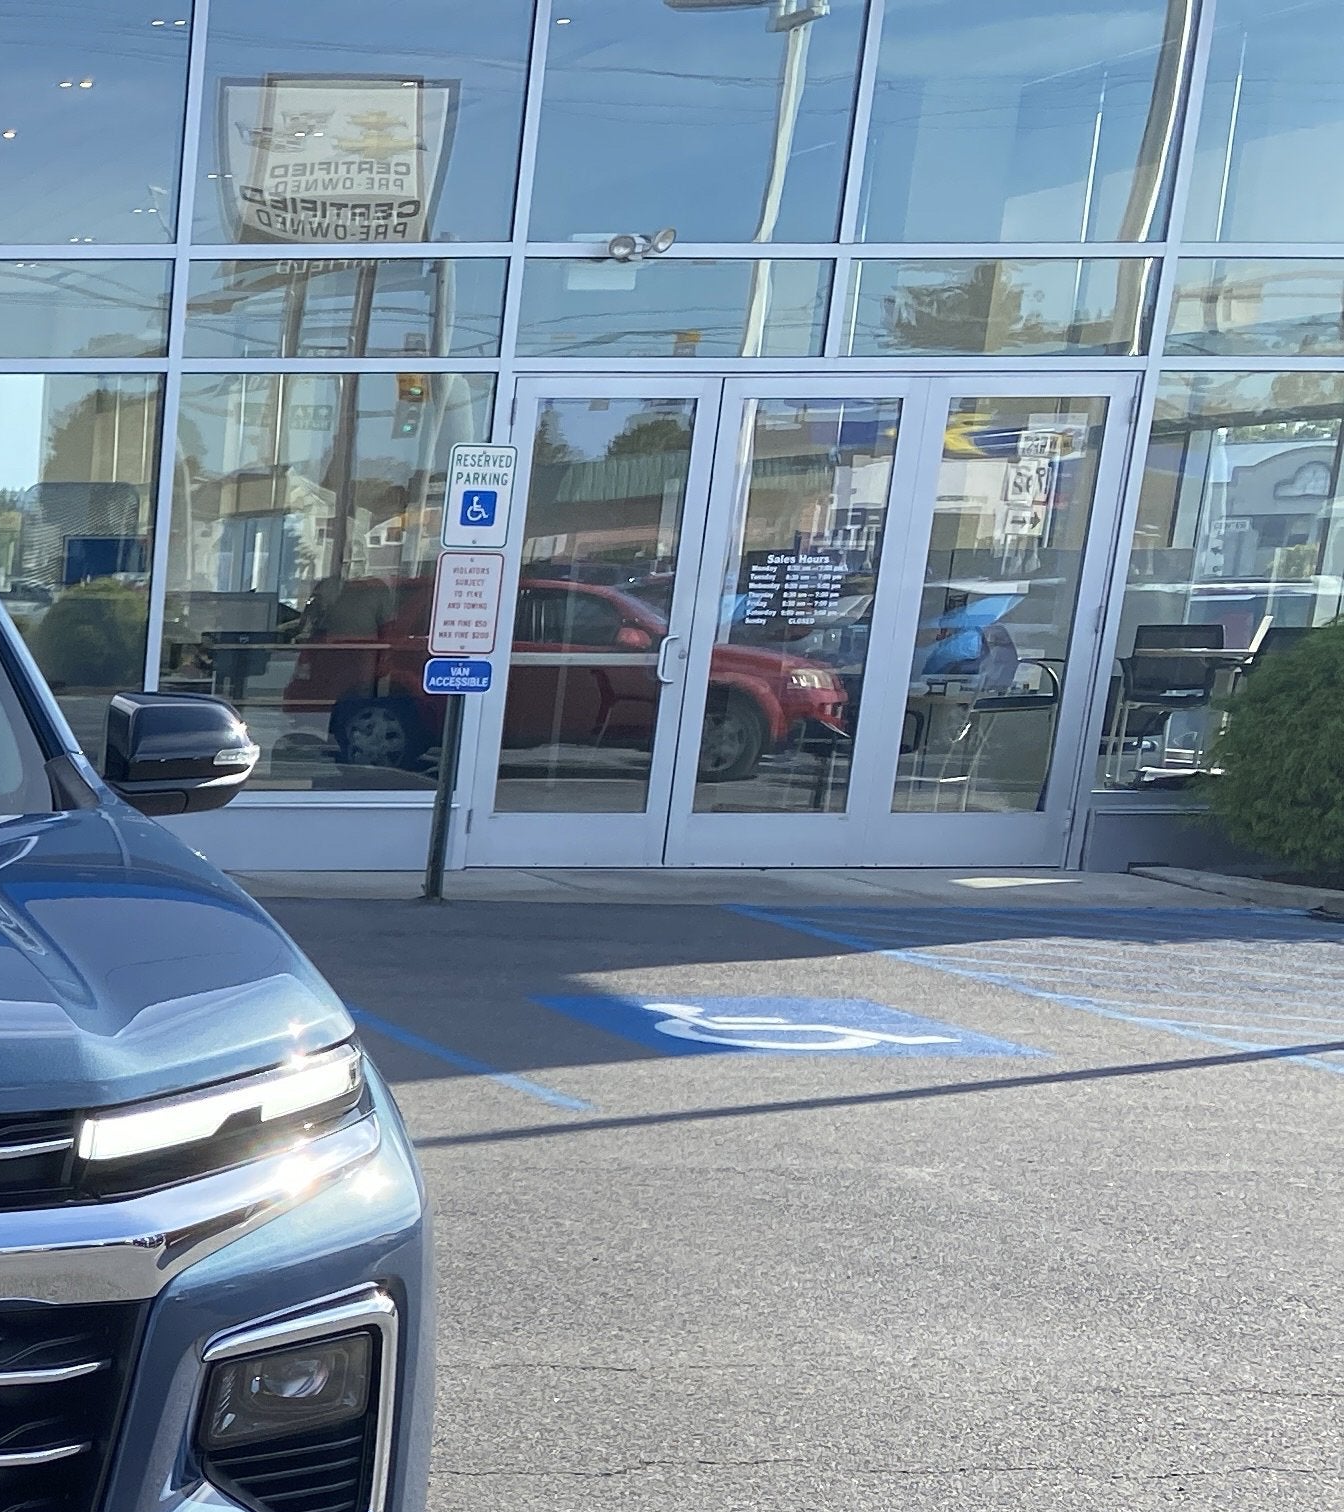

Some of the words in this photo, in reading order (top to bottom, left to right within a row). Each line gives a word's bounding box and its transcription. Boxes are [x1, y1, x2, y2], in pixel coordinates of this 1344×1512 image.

[455, 453, 513, 469] RESERVED
[455, 472, 509, 486] PARKING
[767, 554, 796, 564] Sales
[798, 554, 831, 564] Hours
[452, 566, 490, 575] VIOLATORS
[455, 578, 485, 587] SUBJECT
[450, 666, 471, 677] VAN
[428, 676, 489, 688] ACCESSIBLE
